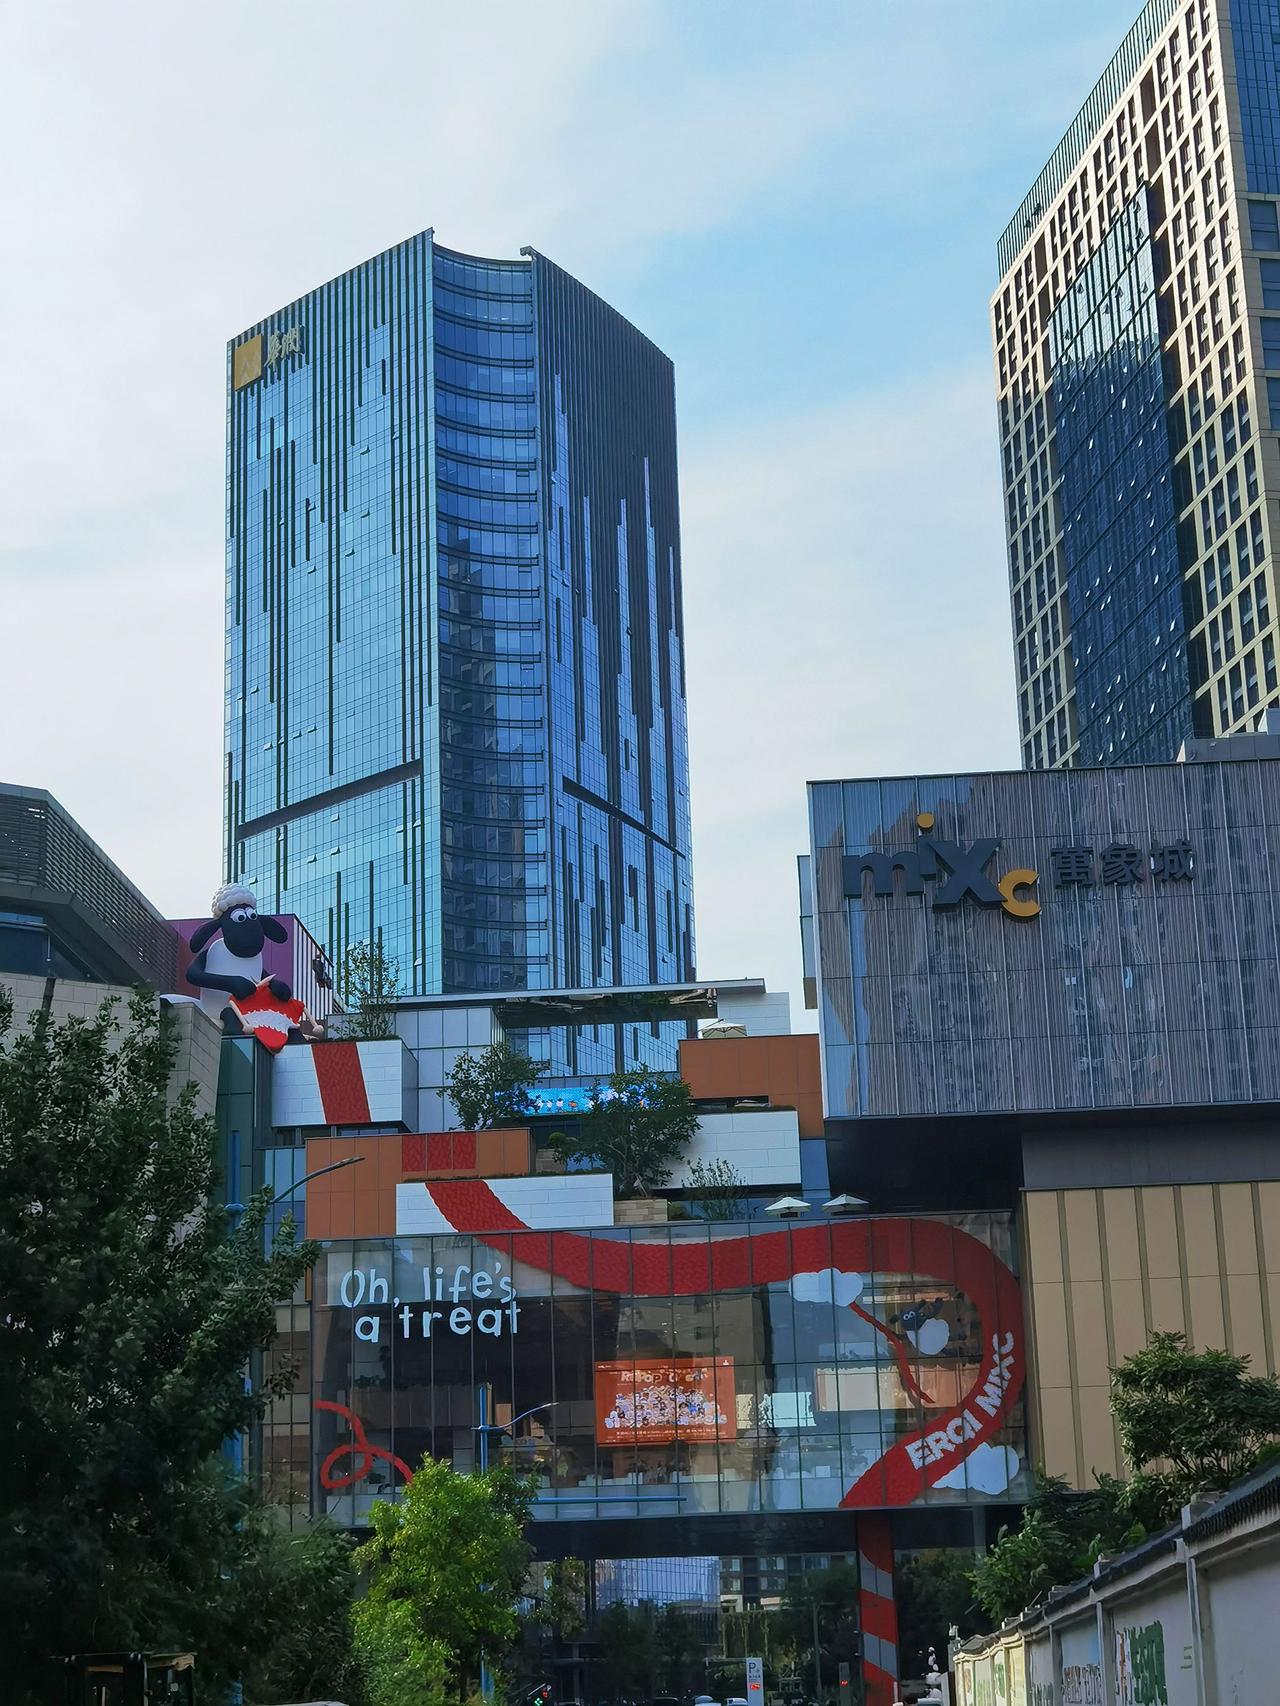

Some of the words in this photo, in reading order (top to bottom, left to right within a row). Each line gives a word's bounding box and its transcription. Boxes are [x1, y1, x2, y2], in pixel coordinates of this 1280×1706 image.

[1050, 839, 1196, 890] 萬象城
[340, 1268, 400, 1308] Oh,
[423, 1262, 517, 1304] life's
[355, 1316, 380, 1342] a
[399, 1301, 521, 1339] treat
[974, 1331, 1015, 1417] MIXC
